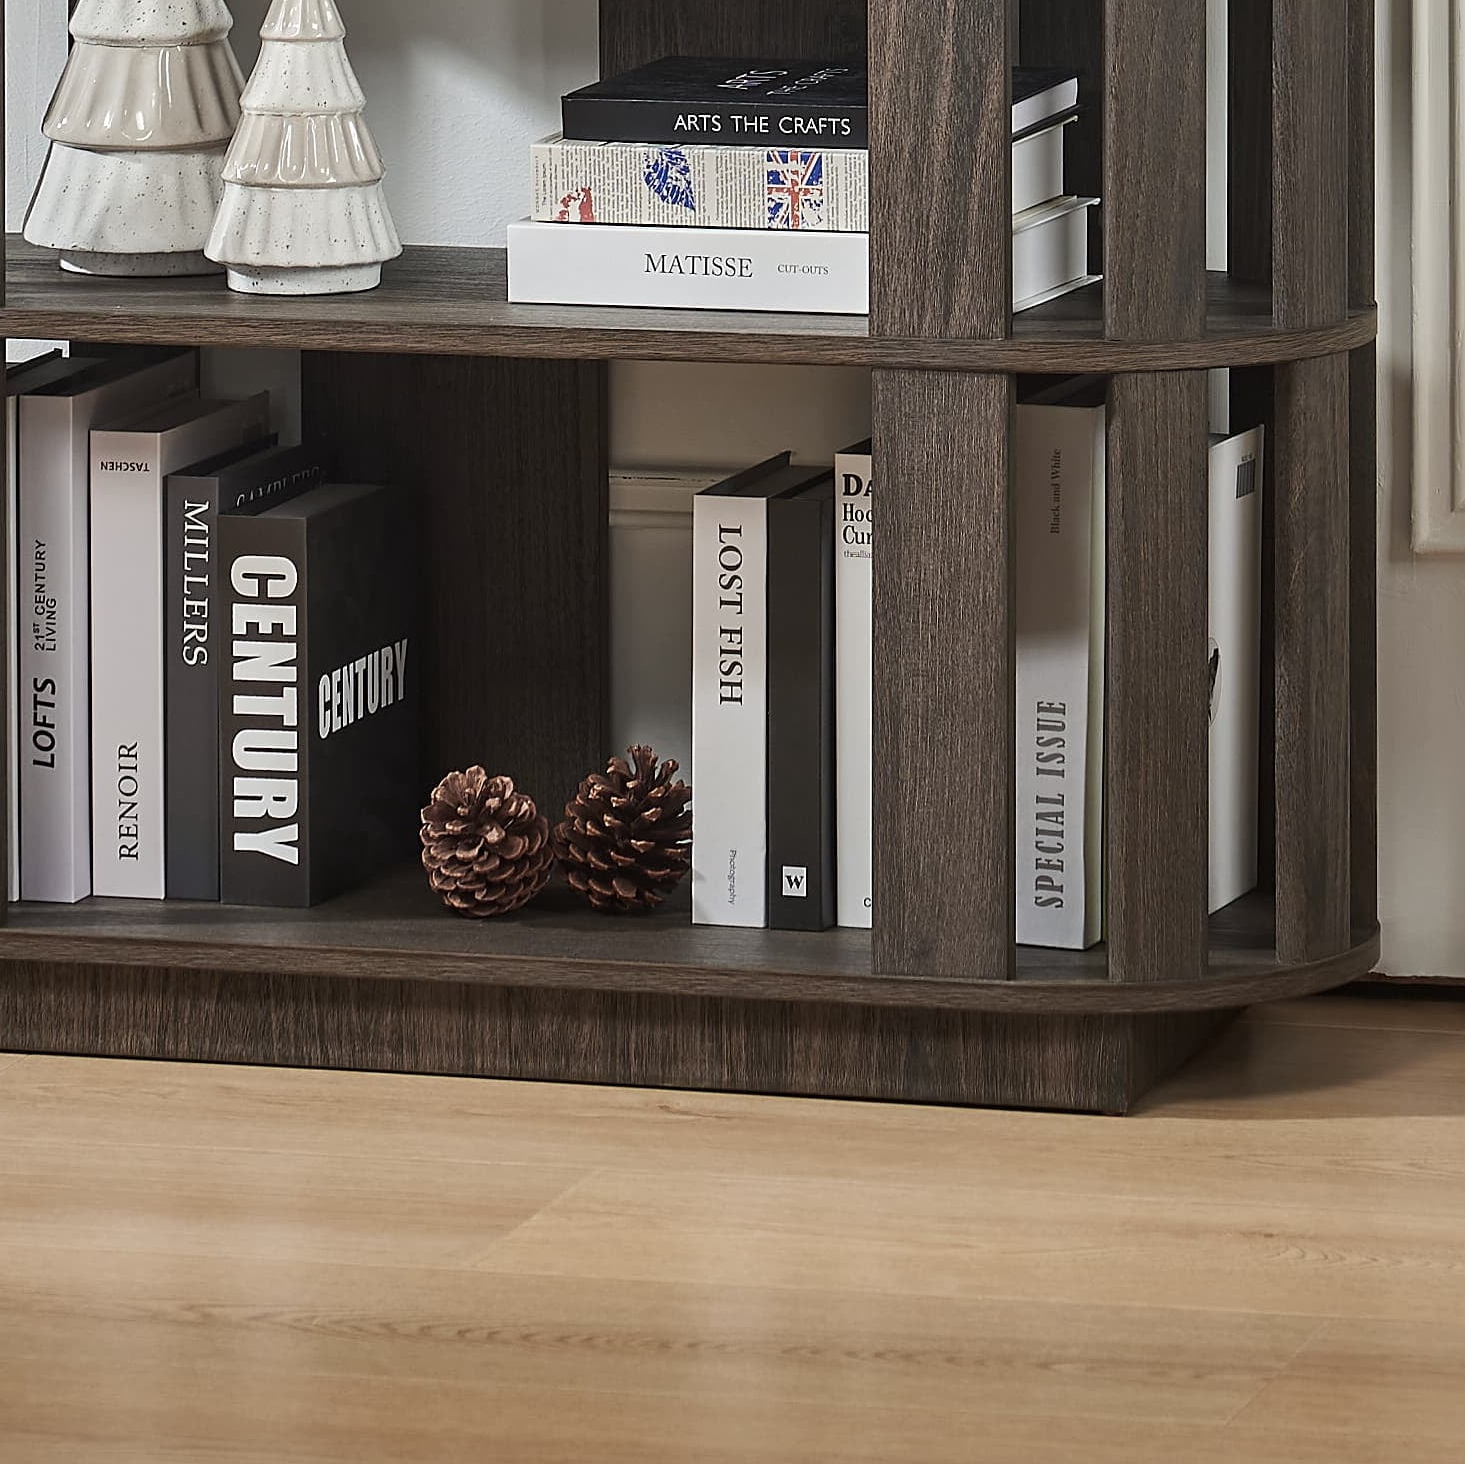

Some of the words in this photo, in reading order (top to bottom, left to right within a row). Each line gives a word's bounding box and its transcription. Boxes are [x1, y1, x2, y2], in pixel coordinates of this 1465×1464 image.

[673, 114, 722, 132] ARTS
[730, 115, 769, 134] THE
[778, 116, 852, 136] CRAFTS
[644, 253, 753, 278] MATISSE
[777, 263, 830, 276] CUT-OUTS
[100, 461, 150, 472] TASCHEN
[1049, 448, 1062, 480] White
[1049, 482, 1061, 503] and
[1049, 504, 1061, 534] Black
[34, 539, 46, 617] CENTURY
[182, 499, 210, 667] MILLERS
[718, 523, 743, 615] LOST
[45, 597, 57, 652] LIVING
[318, 638, 408, 740] CENTURY
[719, 625, 743, 706] FISH
[32, 676, 56, 770] LOFTS
[230, 554, 299, 866] CENTURY
[1036, 700, 1066, 779] ISSUE
[117, 741, 139, 861] RENOIR
[785, 875, 804, 890] W
[1034, 793, 1065, 909] SPECIAL
